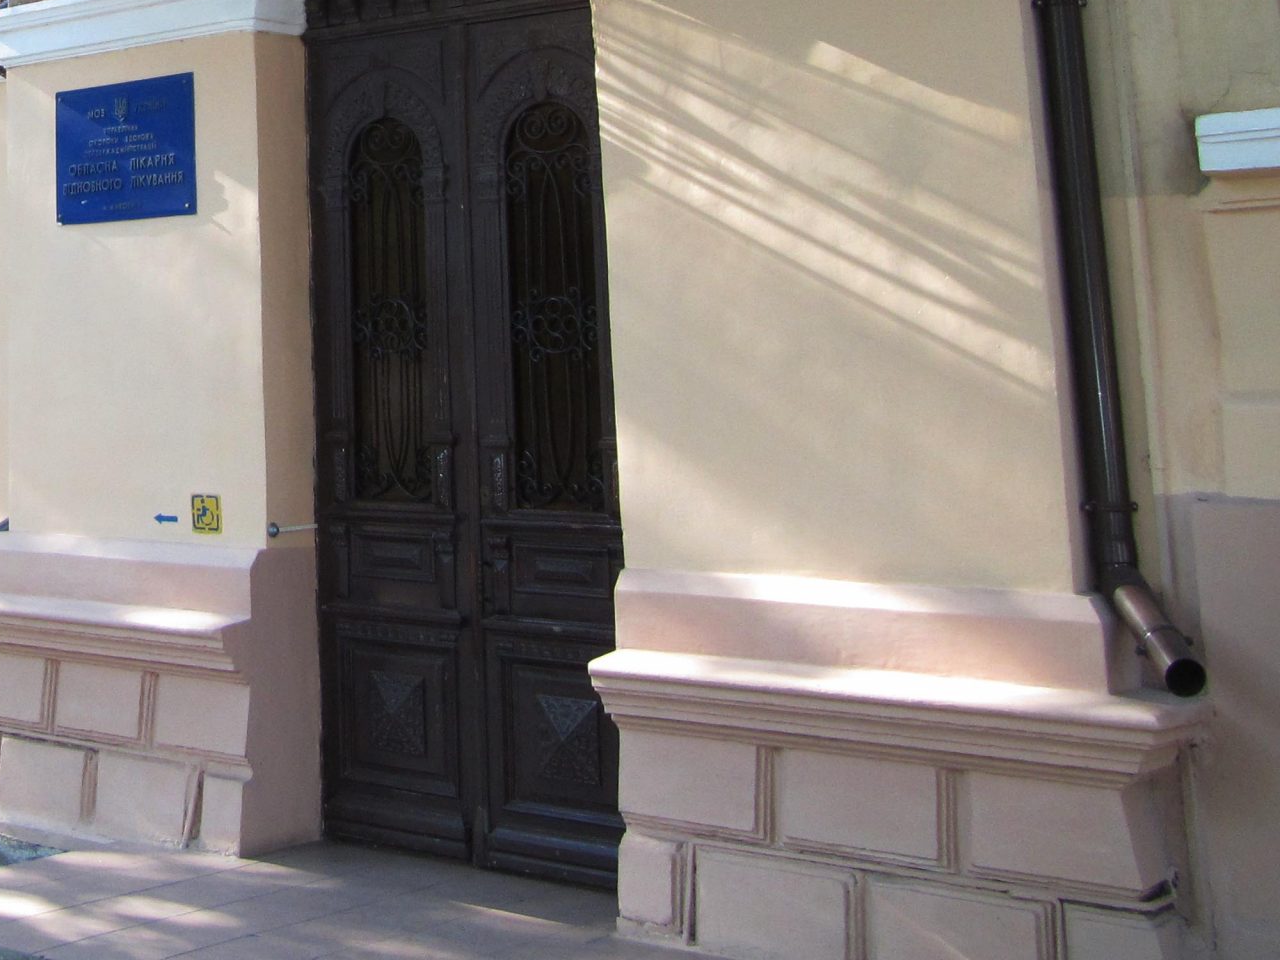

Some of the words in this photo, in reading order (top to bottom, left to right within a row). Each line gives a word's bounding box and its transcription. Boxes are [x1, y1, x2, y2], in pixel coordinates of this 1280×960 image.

[88, 108, 105, 119] МОЗ
[68, 159, 118, 176] ОБЛАСНА
[129, 152, 176, 170] ЛІКАРНЯ
[130, 170, 184, 189] ЛІКУВАННЯ
